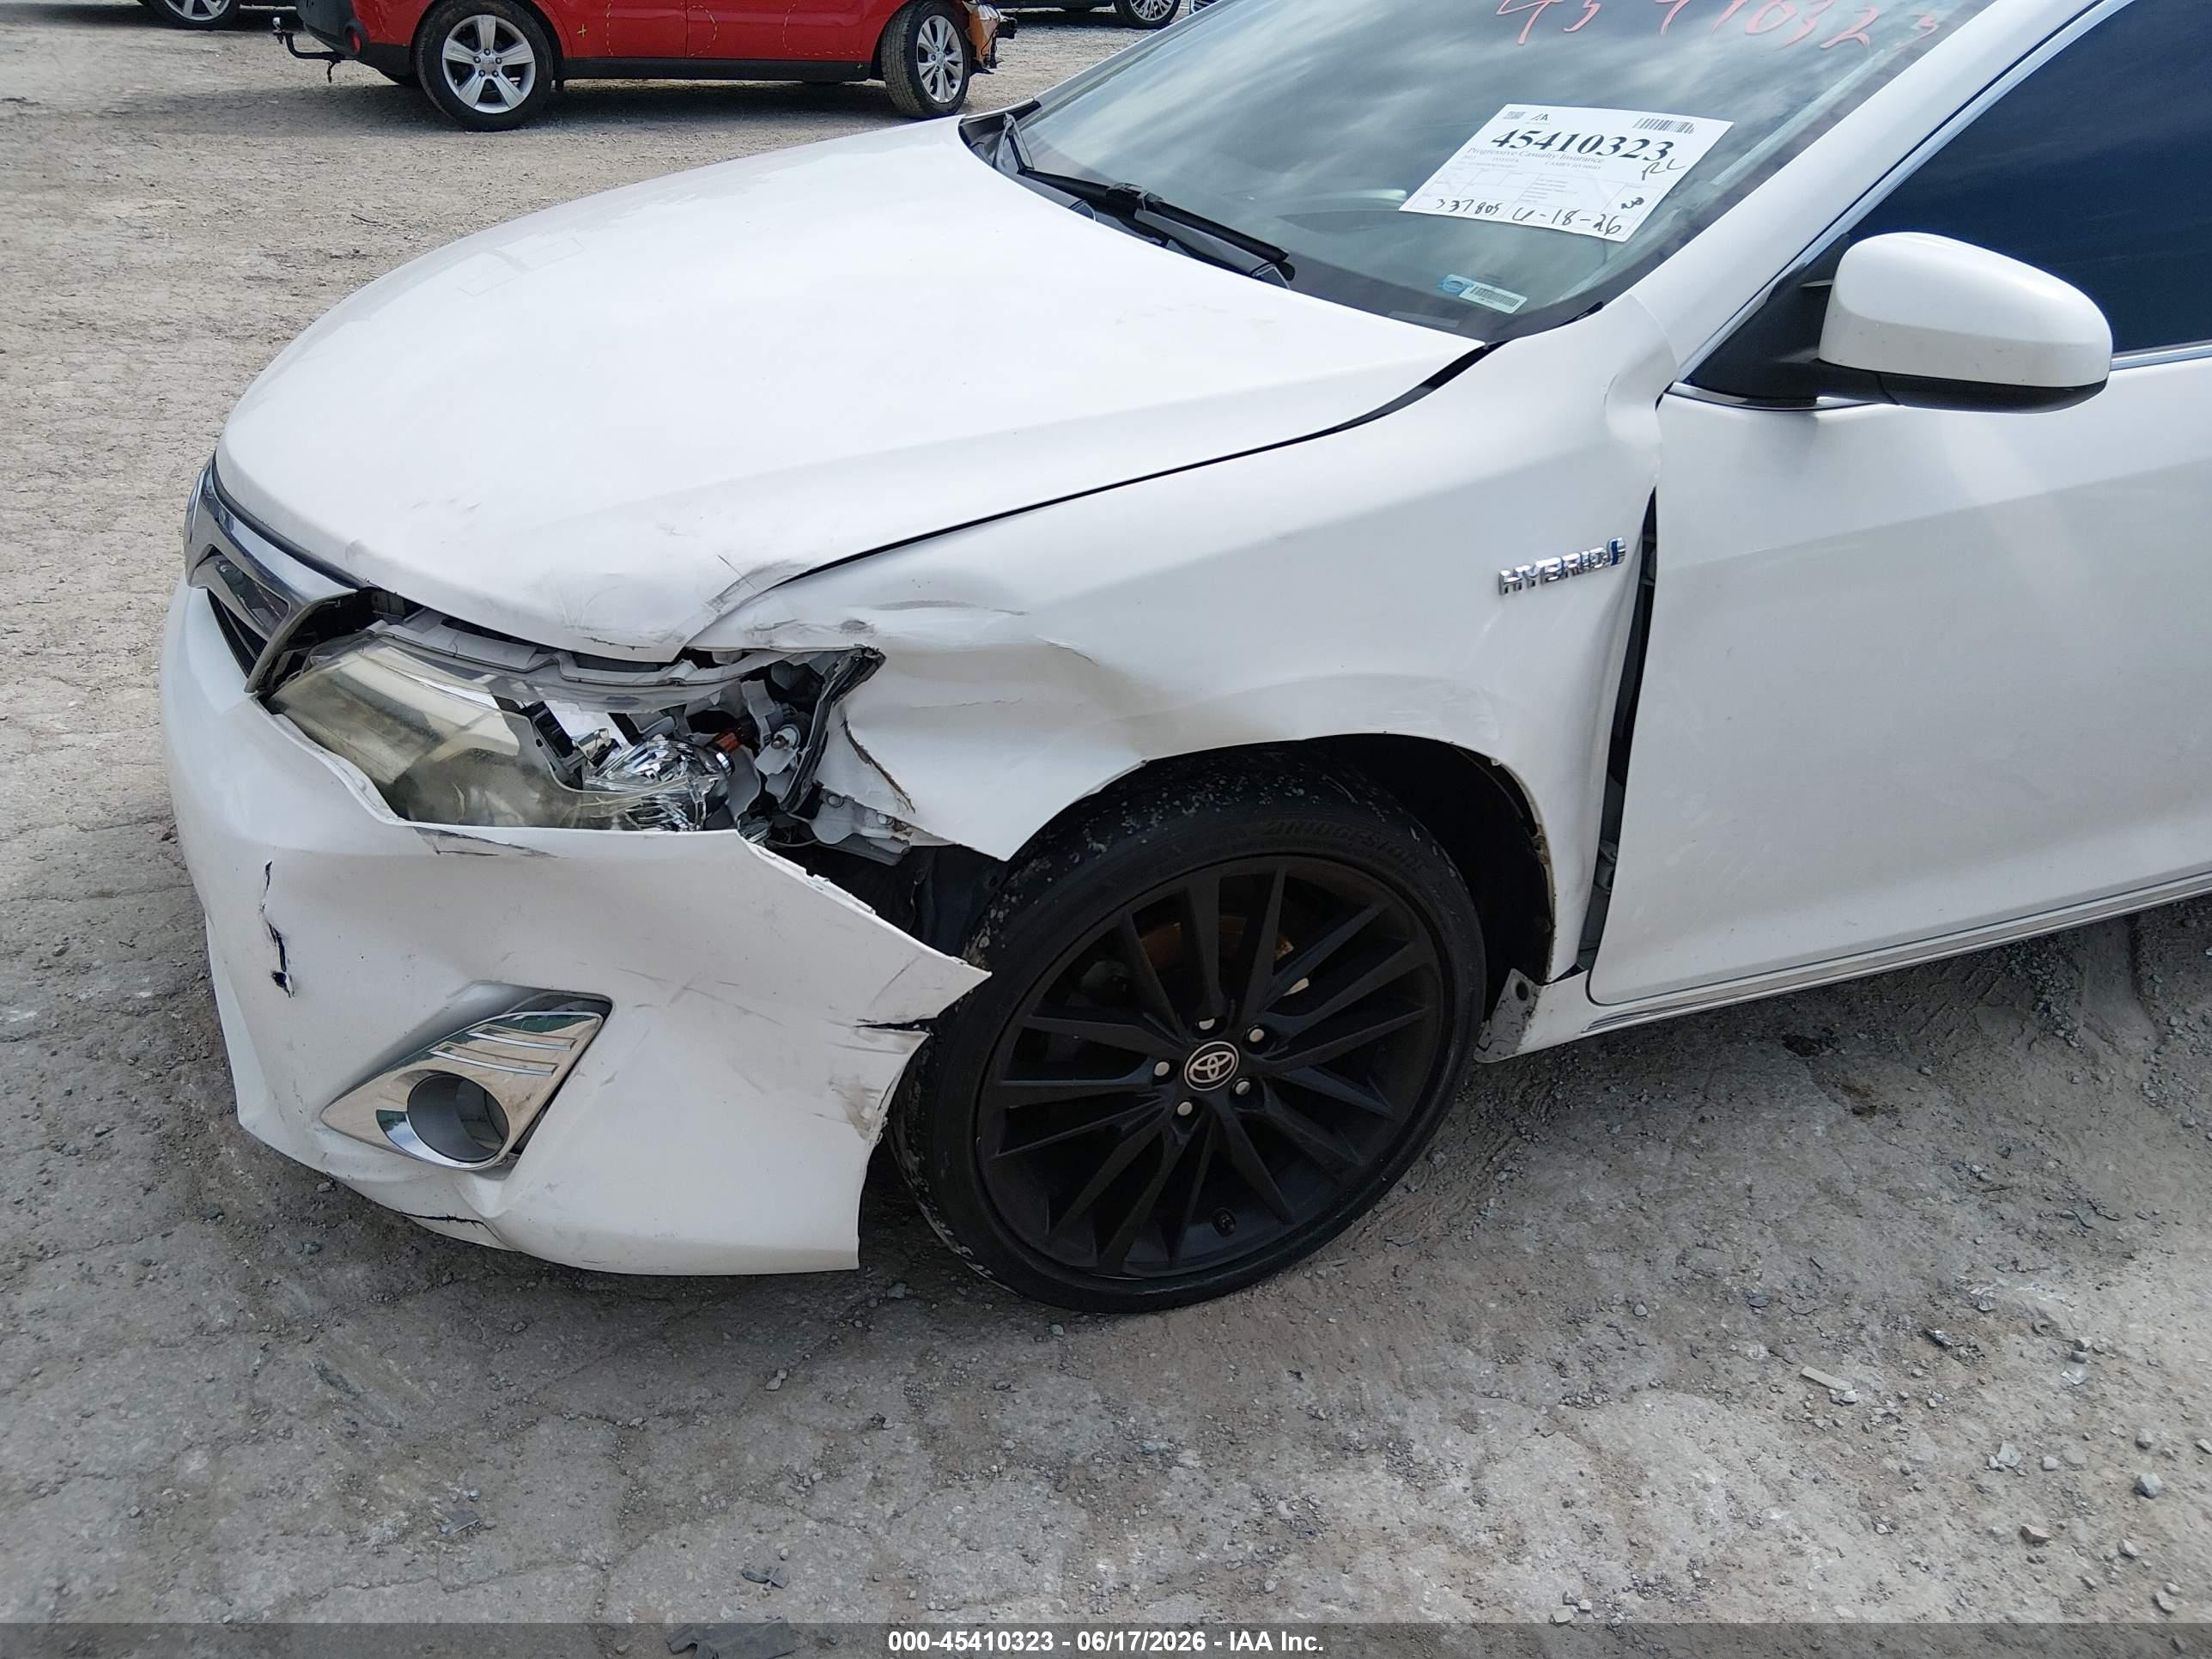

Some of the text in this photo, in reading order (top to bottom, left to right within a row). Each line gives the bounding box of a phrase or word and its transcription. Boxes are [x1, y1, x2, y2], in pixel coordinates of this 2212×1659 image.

[1491, 129, 1674, 161] 45410323
[1519, 150, 1556, 161] Casualty
[1559, 153, 1604, 163] Insurance
[1498, 546, 1608, 595] HYBRID
